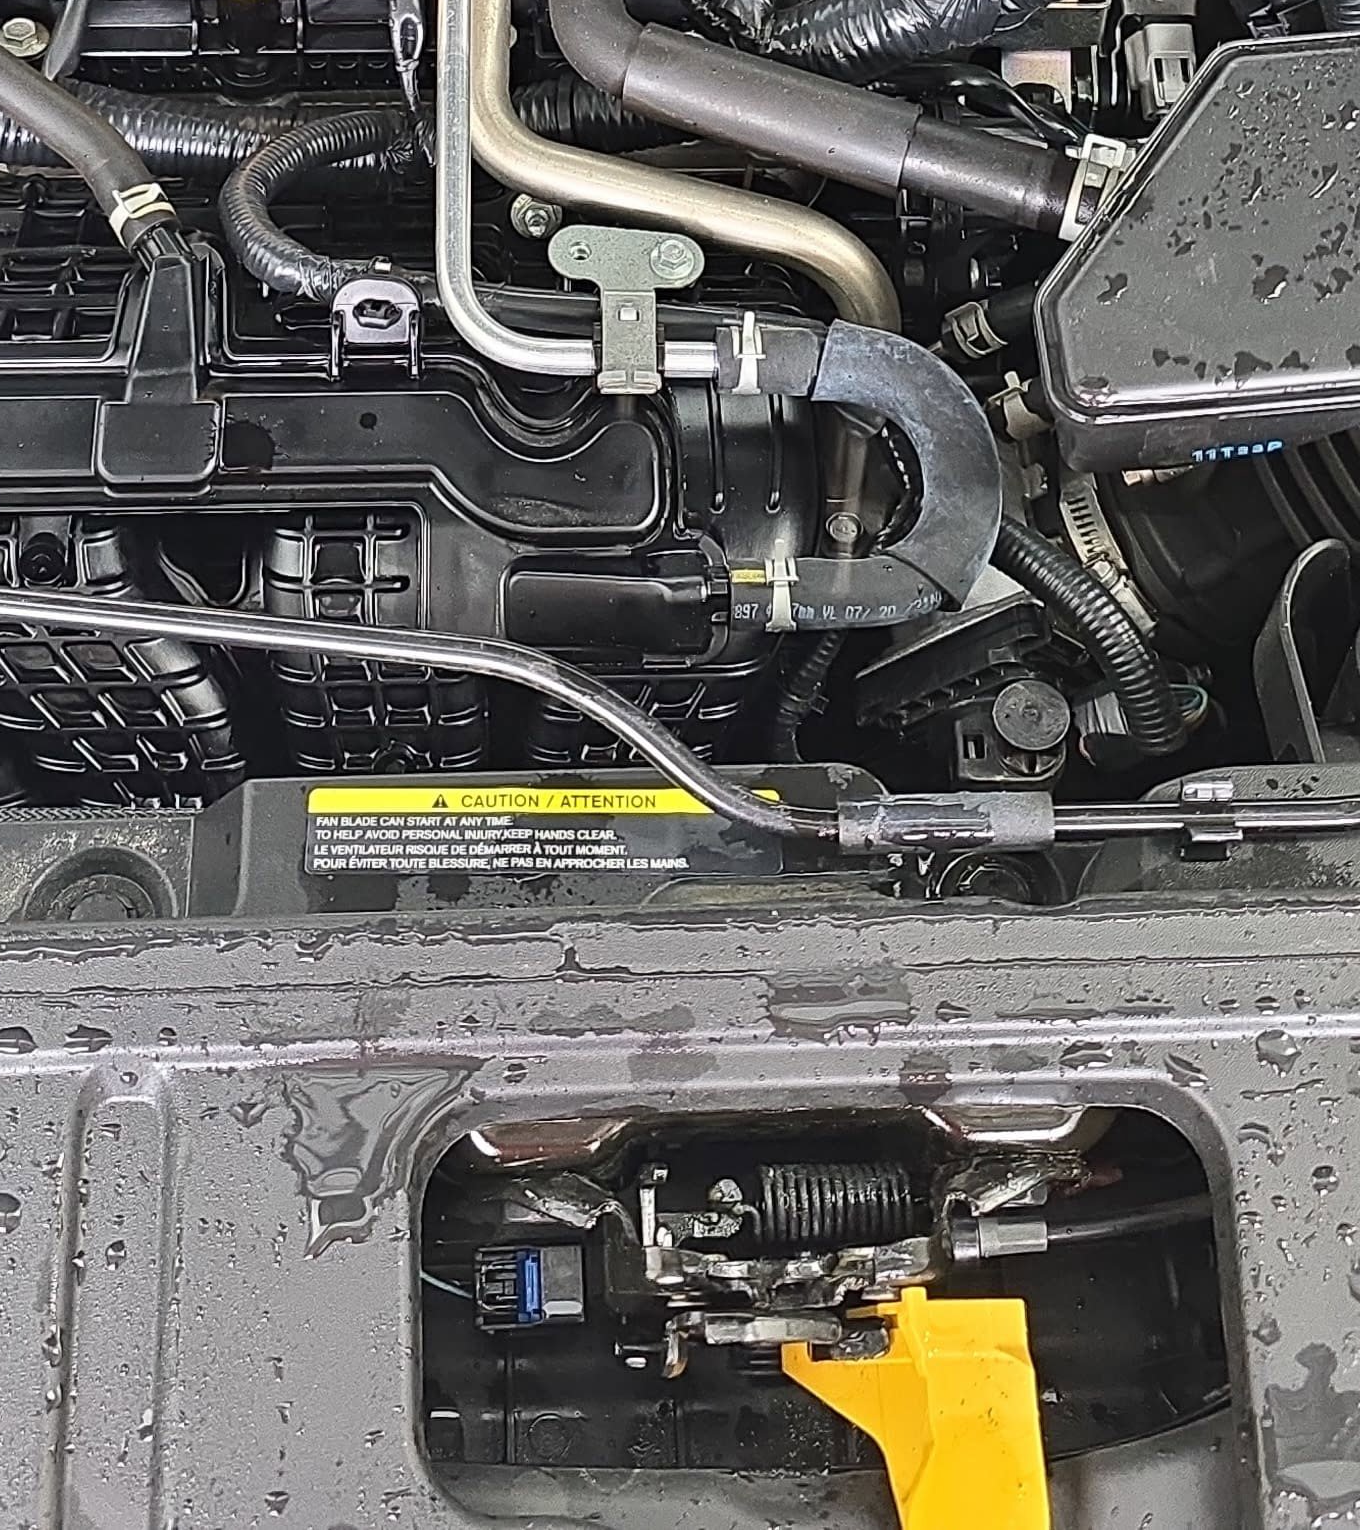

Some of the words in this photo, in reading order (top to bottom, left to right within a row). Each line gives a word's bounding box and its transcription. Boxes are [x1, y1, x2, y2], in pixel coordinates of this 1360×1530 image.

[461, 795, 539, 808] CAUTION
[546, 794, 555, 808] /
[560, 795, 656, 808] ATTENTION
[317, 816, 338, 827] FAN
[341, 816, 377, 827] BLADE
[380, 816, 404, 827] CAN
[407, 816, 441, 827] START
[444, 816, 457, 827] AT
[460, 816, 483, 827] ANY
[316, 829, 331, 840] TO
[333, 829, 363, 840] HELP
[365, 829, 399, 840] AVOID
[402, 829, 464, 840] PERSONAL
[535, 829, 574, 840] HANDS
[577, 829, 617, 840] CLEAR.
[314, 844, 328, 855] LE
[330, 844, 404, 855] VENTILATEUR
[406, 844, 448, 855] RISQUE
[451, 844, 466, 855] DE
[469, 842, 532, 855] DÉMARRER
[533, 842, 542, 854] À
[544, 844, 572, 855] TOUT
[576, 844, 627, 855] MOMENT.
[313, 858, 347, 869] POUR
[349, 856, 387, 868] ÉVITER
[390, 858, 427, 869] TOUTE
[429, 858, 491, 870] BLESSURE,
[493, 858, 509, 869] NE
[511, 858, 533, 869] PAS
[536, 858, 551, 869] EN
[553, 858, 625, 869] APPROCHER
[627, 858, 648, 869] LES
[651, 858, 689, 869] MAINS.
